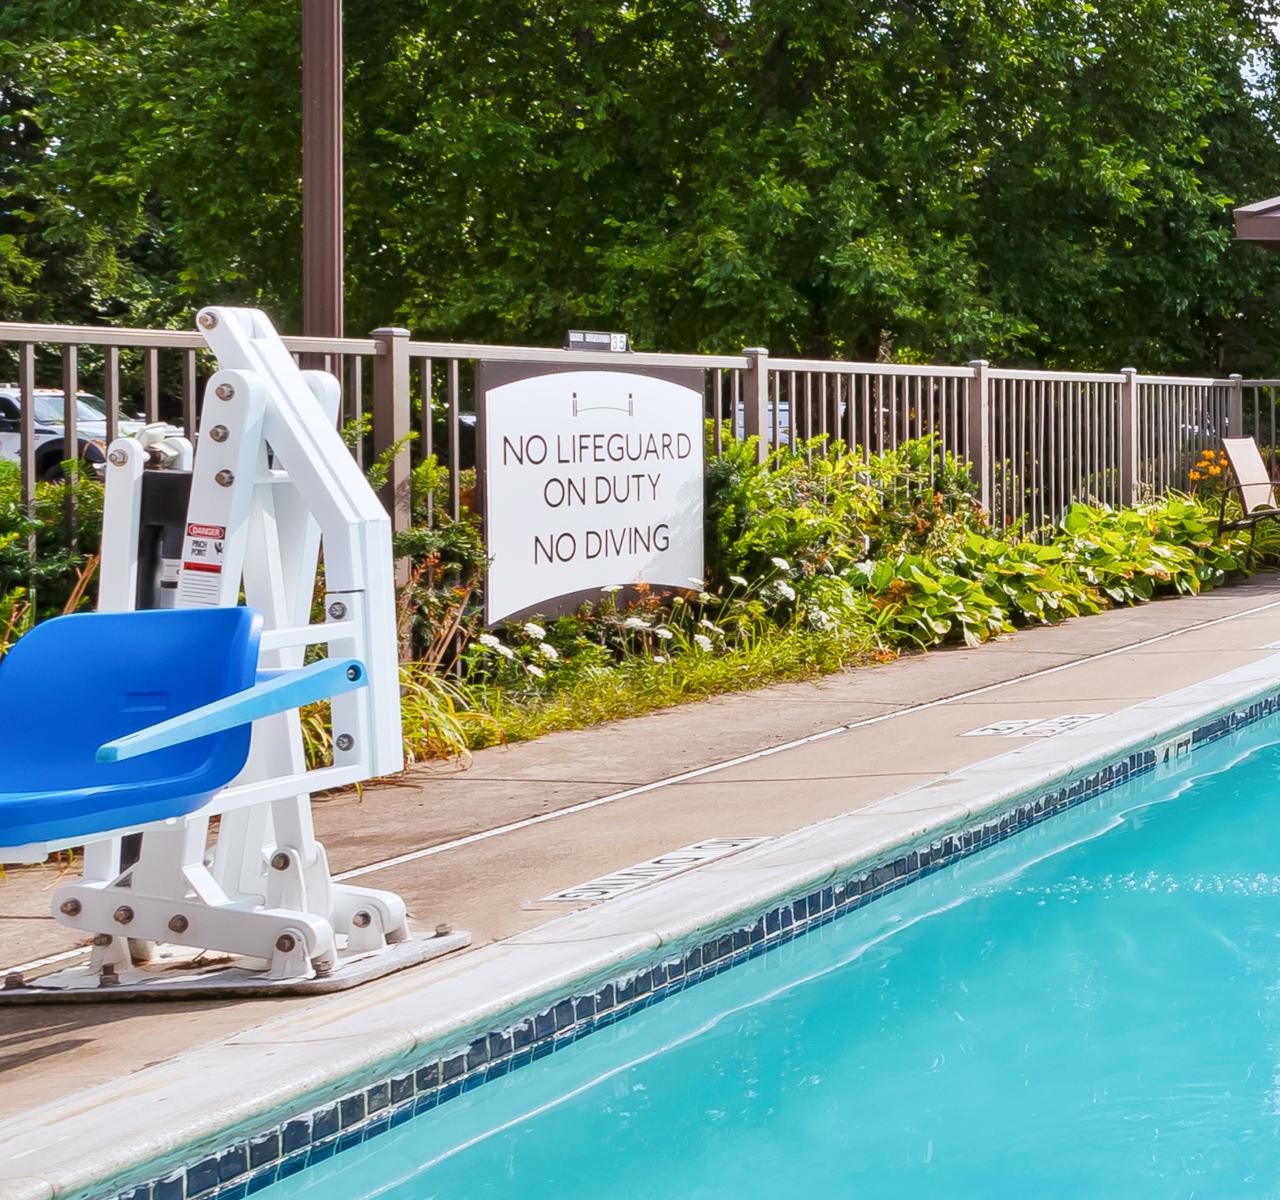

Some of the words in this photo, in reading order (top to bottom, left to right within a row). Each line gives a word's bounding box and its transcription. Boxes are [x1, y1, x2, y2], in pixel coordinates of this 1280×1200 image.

[503, 434, 548, 466] NO
[557, 432, 692, 464] LIFEGUARD
[543, 476, 587, 508] ON
[595, 473, 662, 505] DUTY
[534, 531, 577, 566] NO
[586, 523, 670, 560] DIVING
